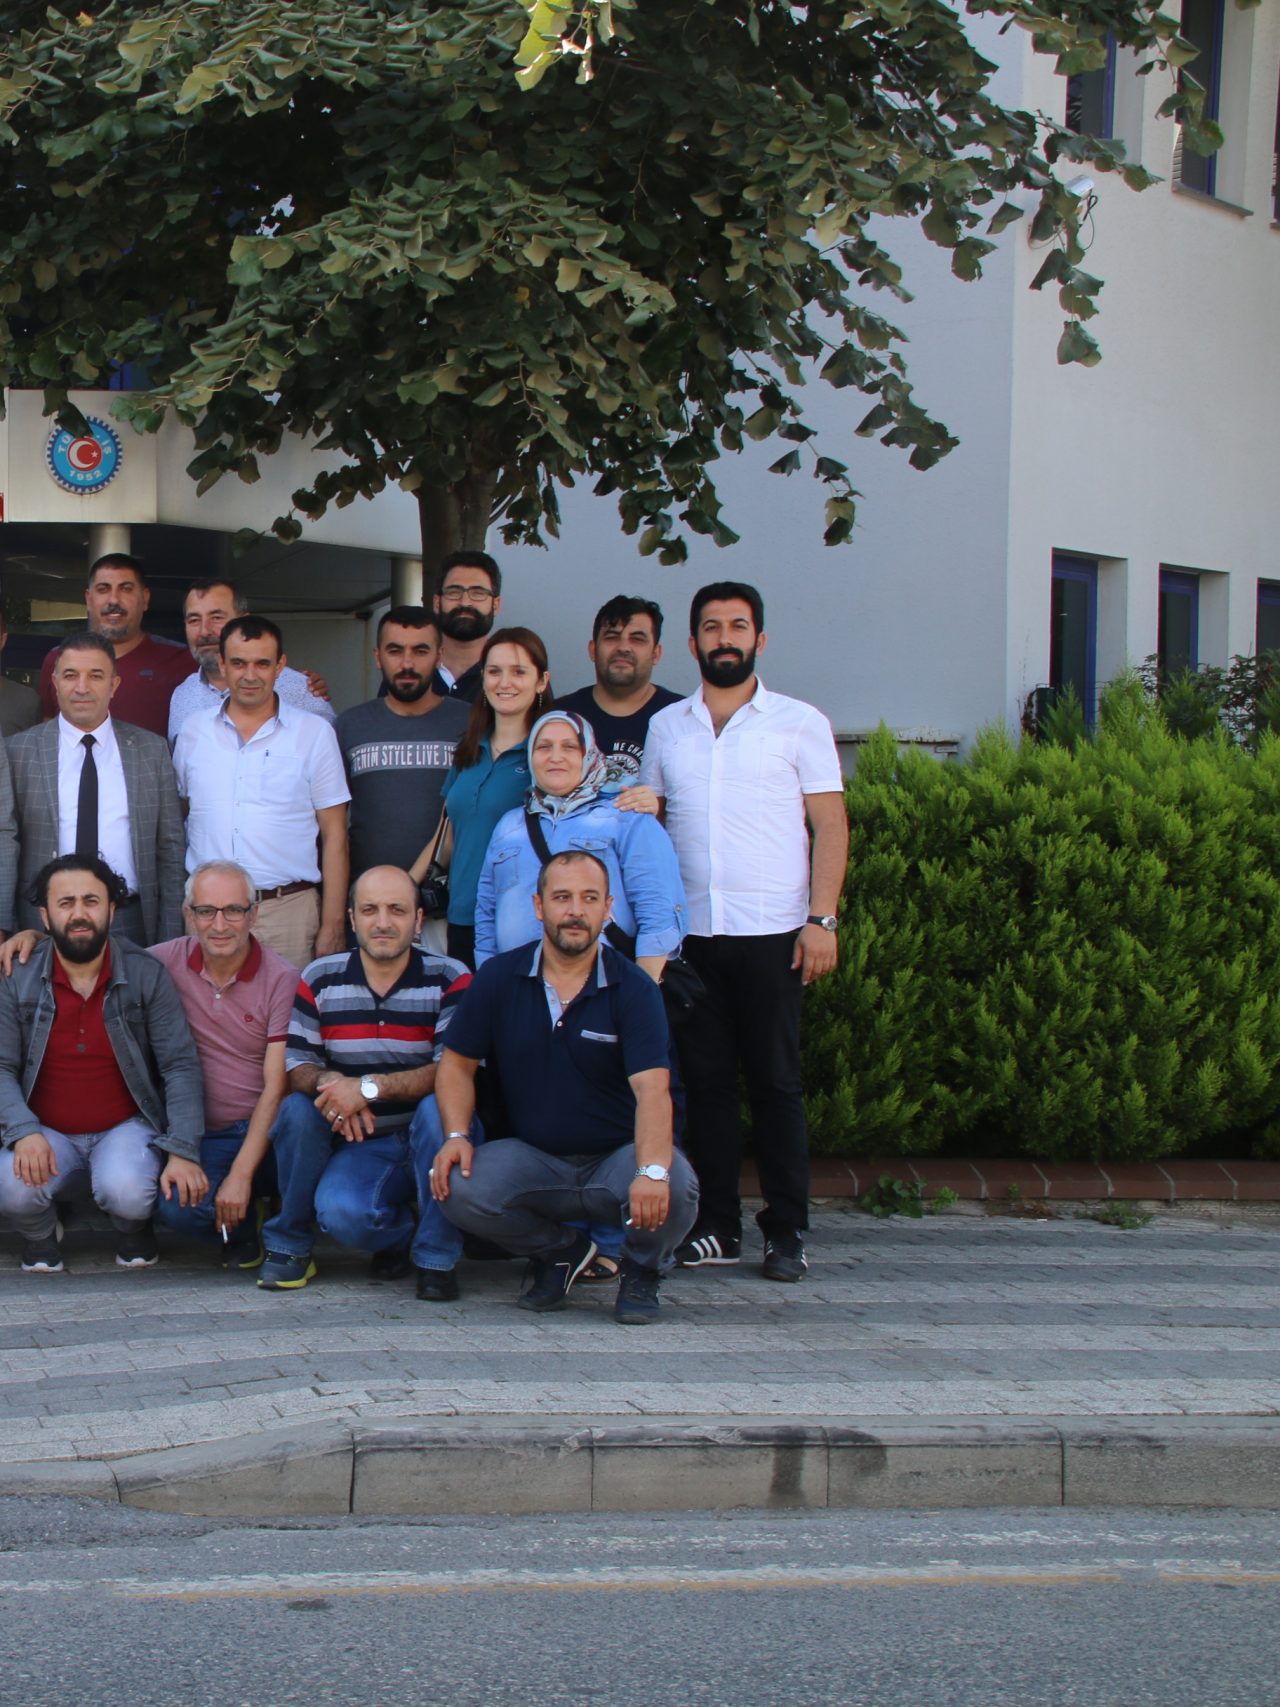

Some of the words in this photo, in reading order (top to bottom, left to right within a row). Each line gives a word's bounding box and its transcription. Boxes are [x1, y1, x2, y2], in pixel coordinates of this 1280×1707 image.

[69, 469, 103, 481] 1952
[381, 744, 414, 767] STYLE
[415, 744, 440, 767] LIVE
